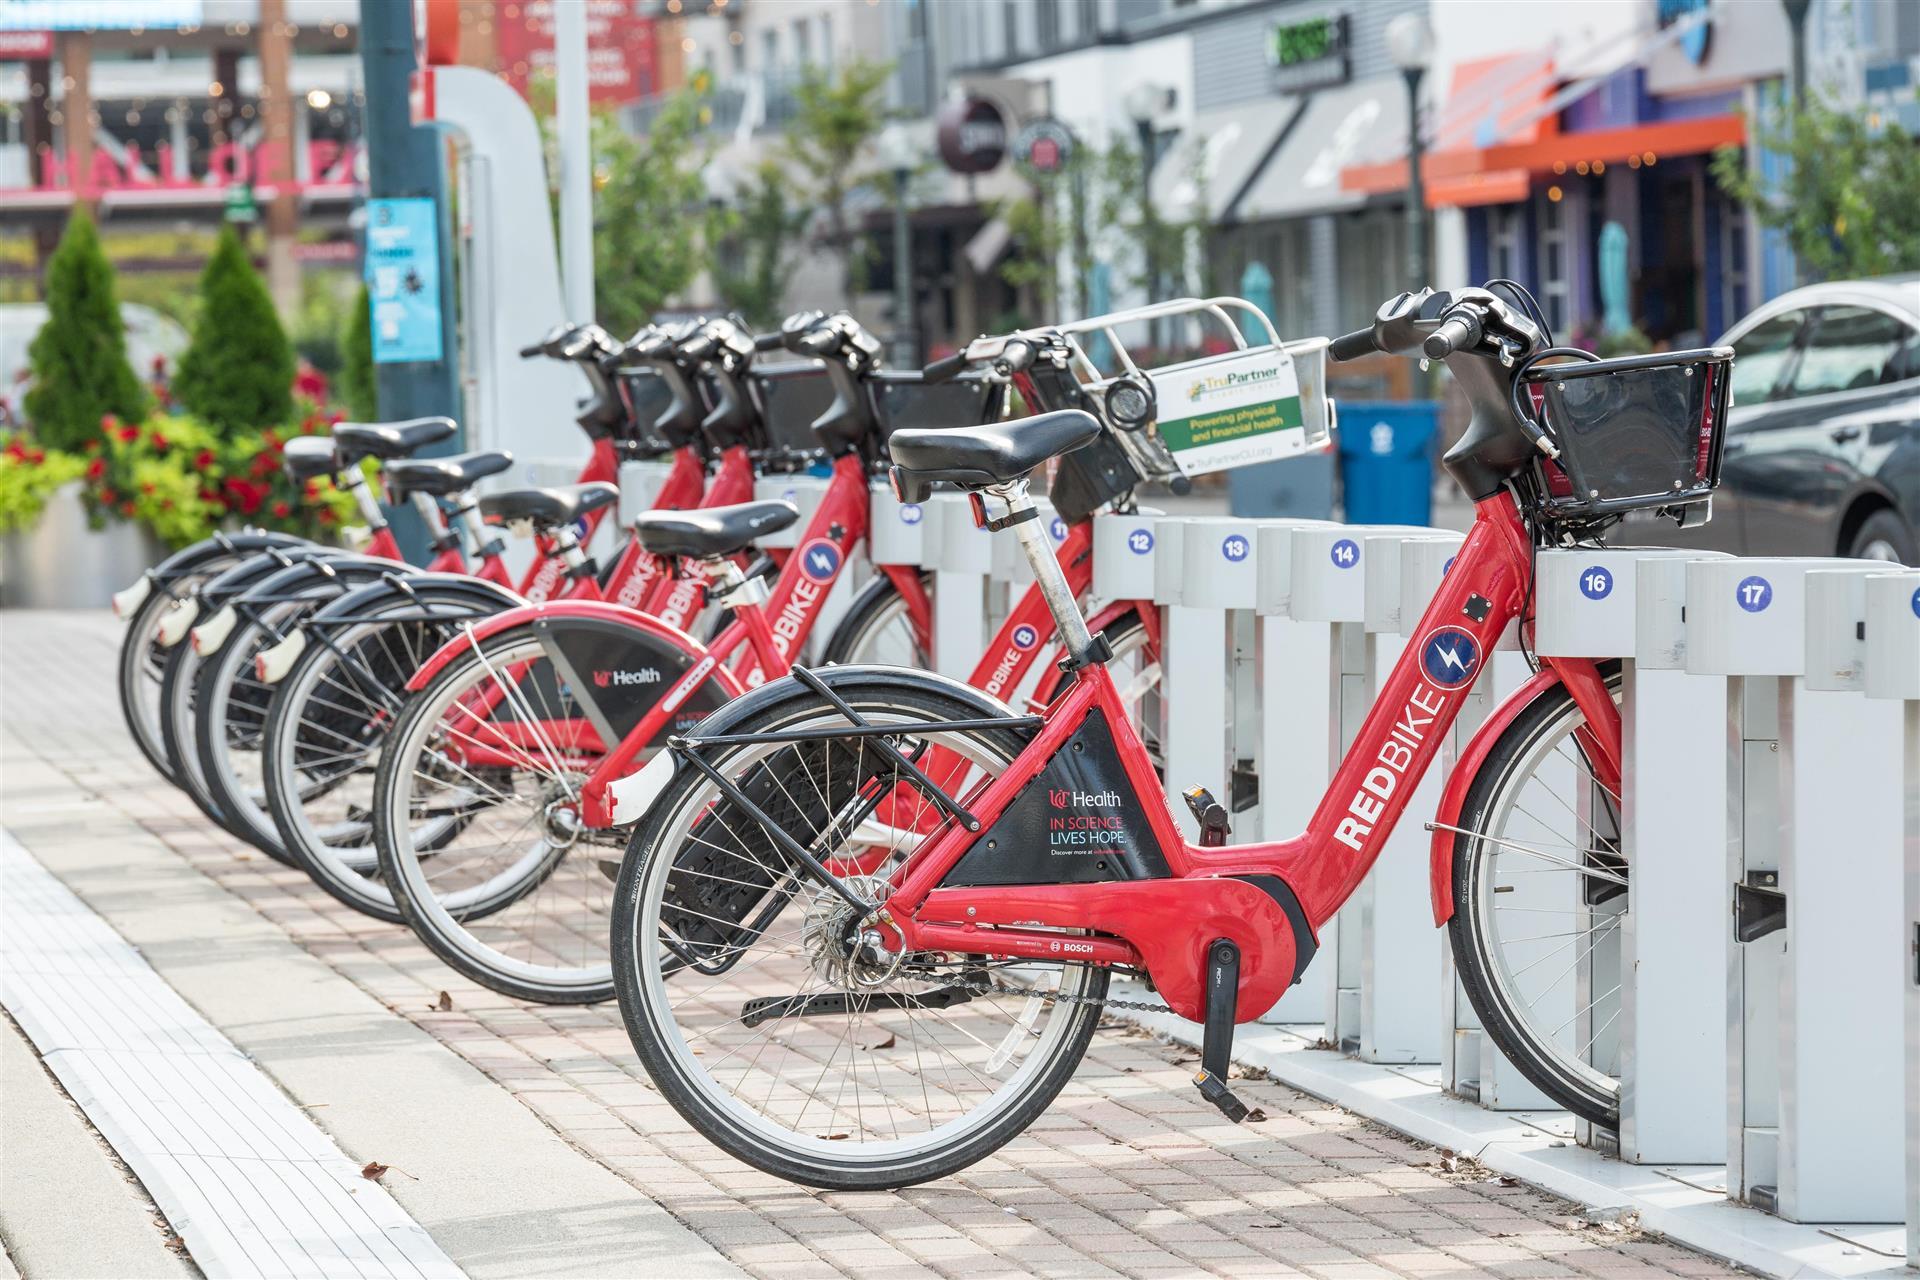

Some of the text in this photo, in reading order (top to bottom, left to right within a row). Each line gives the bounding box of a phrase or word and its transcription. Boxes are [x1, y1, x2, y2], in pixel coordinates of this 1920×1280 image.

[1205, 367, 1279, 389] TruPartner
[1190, 404, 1276, 429] Powering physical
[1192, 416, 1283, 442] and financial health
[1131, 535, 1149, 550] 12
[1226, 540, 1243, 556] 13
[1335, 546, 1354, 562] 14
[1585, 574, 1606, 592] 16
[1742, 585, 1765, 604] 17
[613, 667, 660, 685] Health
[1334, 682, 1446, 851] REDBIKE
[1072, 790, 1121, 807] Health
[1050, 816, 1123, 830] IN SCIENCE
[1050, 830, 1127, 845] LIVES HOPE.
[1063, 943, 1094, 953] BOSCH
